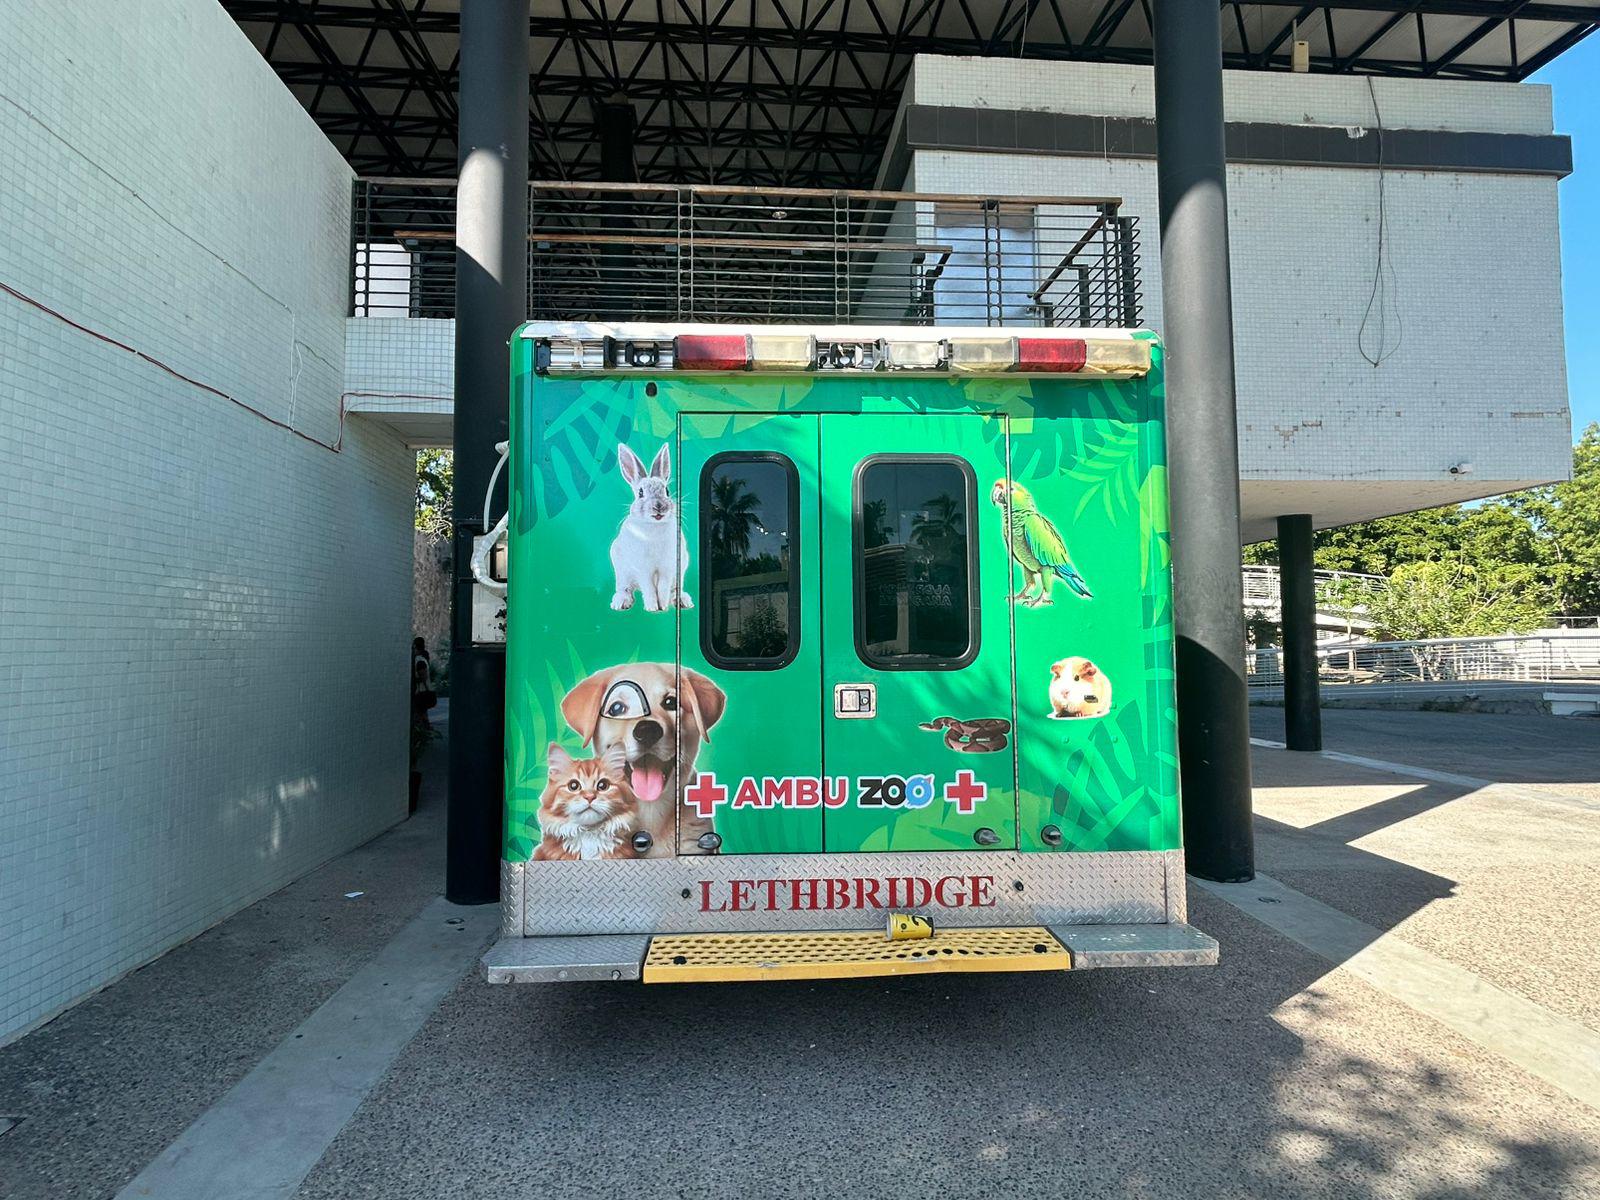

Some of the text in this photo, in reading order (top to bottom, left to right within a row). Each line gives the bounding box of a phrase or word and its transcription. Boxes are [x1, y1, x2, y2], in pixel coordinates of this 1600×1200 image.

[732, 775, 935, 808] AMBU ZOO
[698, 875, 995, 912] LETHBRIDGE
